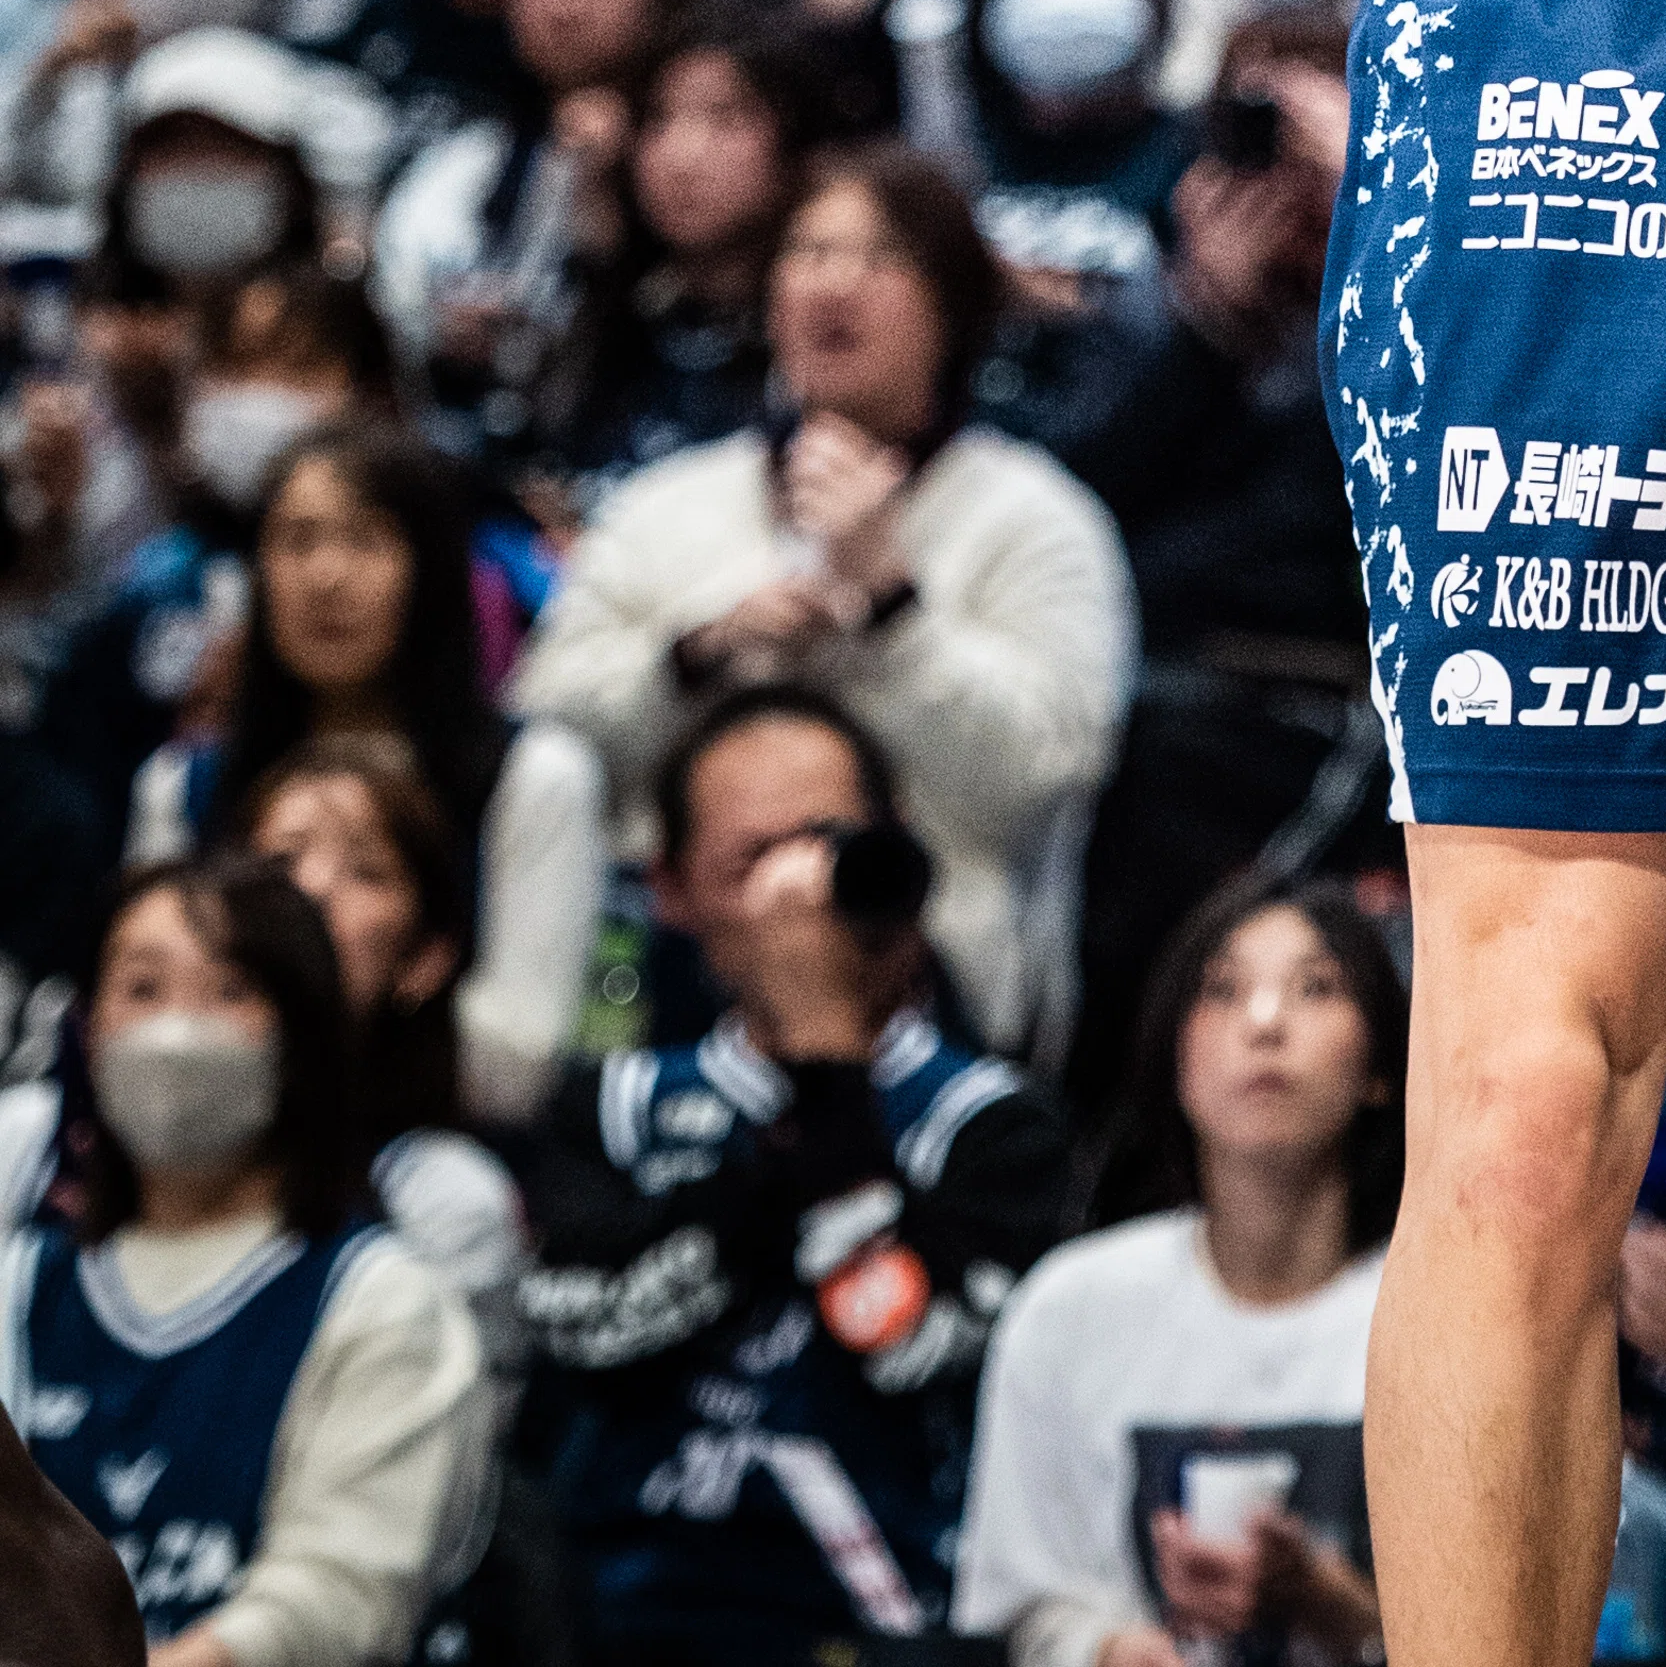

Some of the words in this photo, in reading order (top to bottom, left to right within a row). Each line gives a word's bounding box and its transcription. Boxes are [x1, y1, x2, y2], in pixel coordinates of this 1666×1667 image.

[1477, 69, 1665, 149] BENEX
[1471, 145, 1657, 188] 日本ベネックス
[1446, 448, 1490, 511] NT
[1488, 555, 1572, 631] K&B
